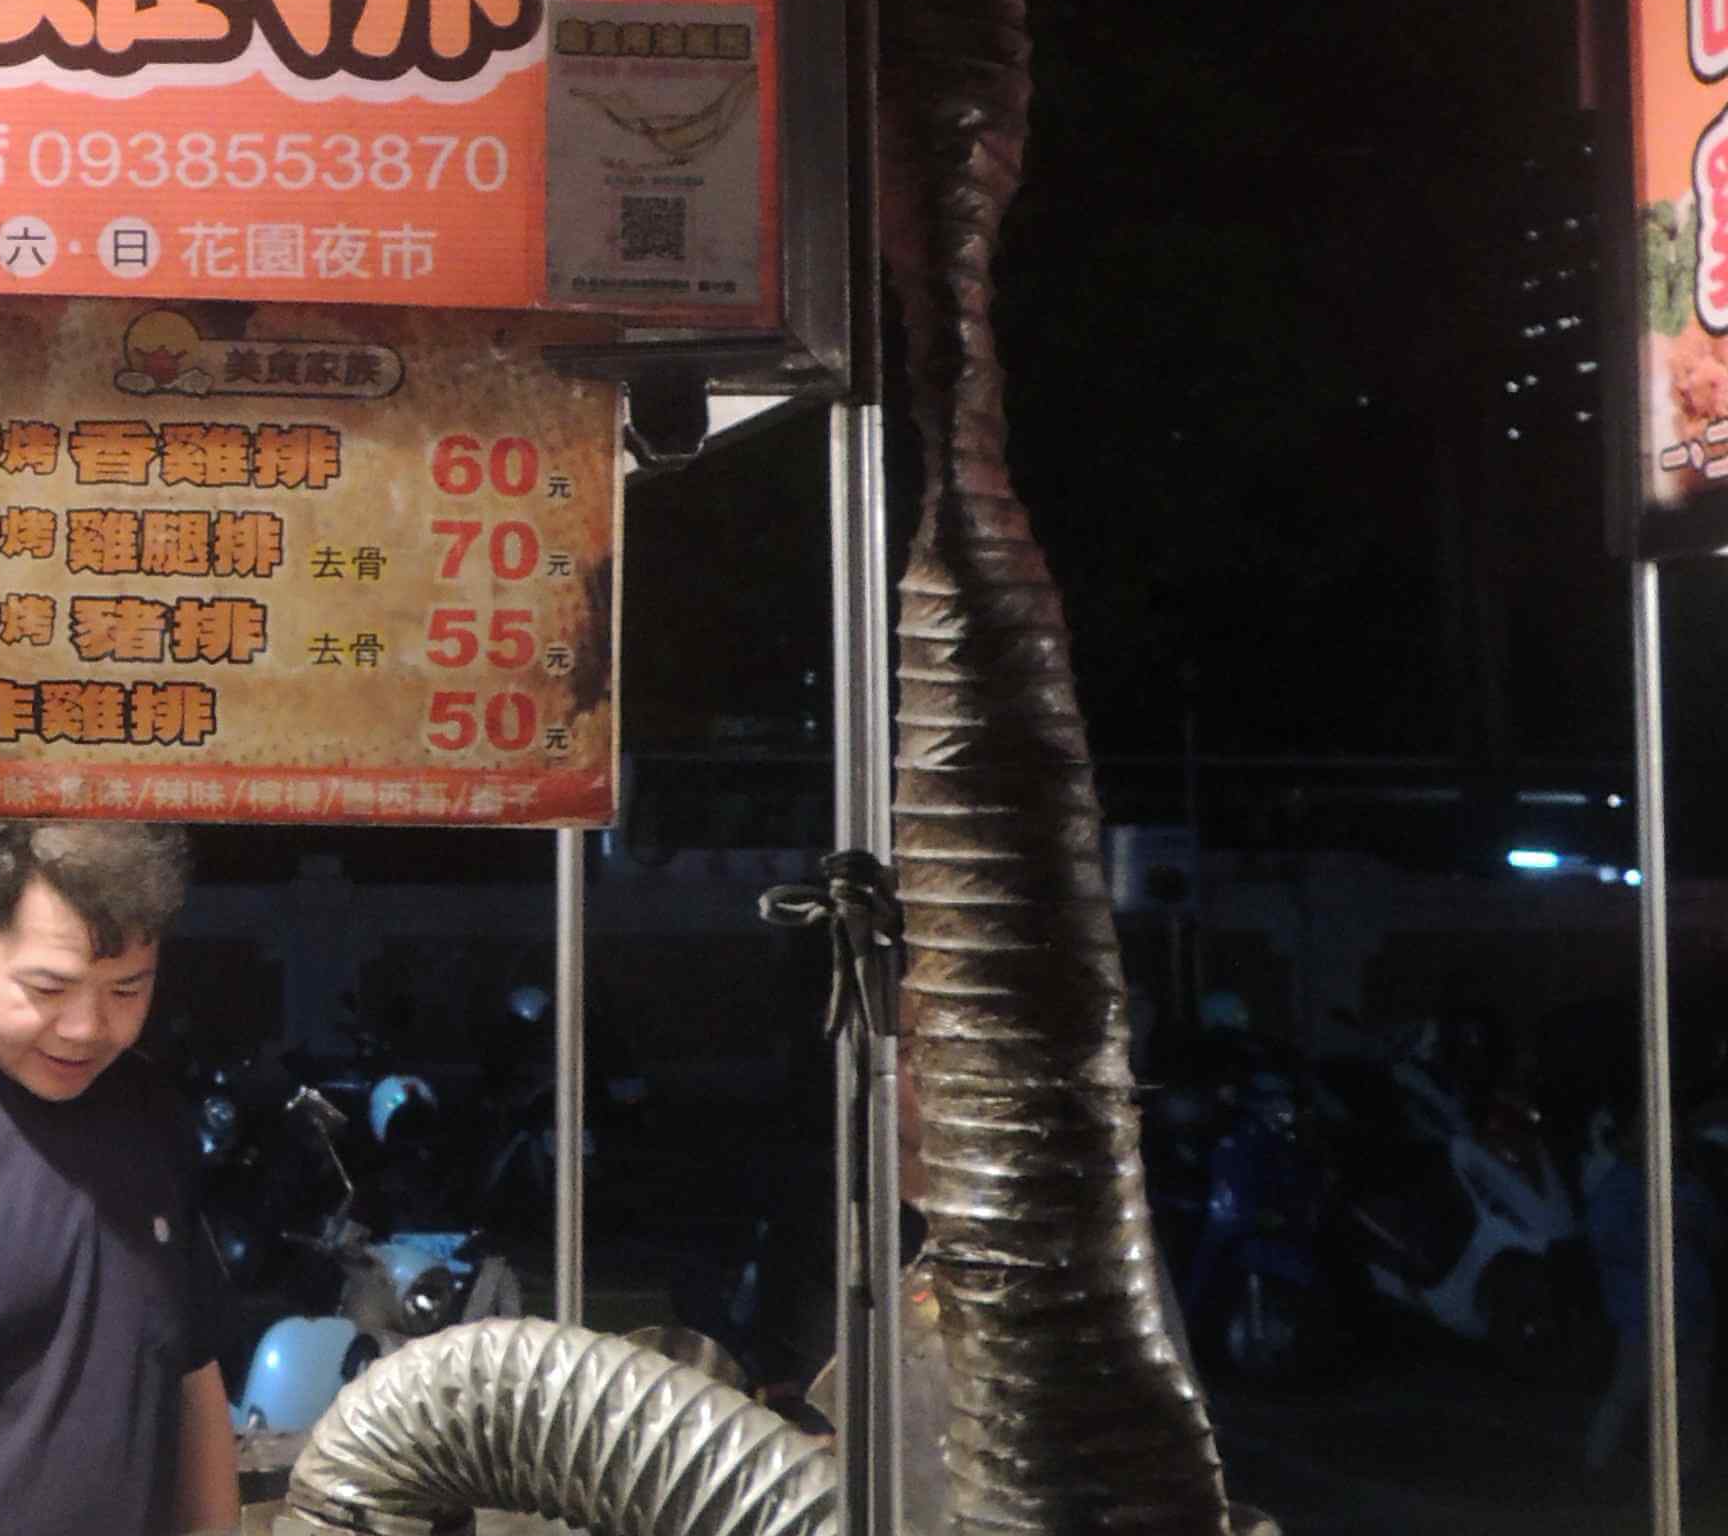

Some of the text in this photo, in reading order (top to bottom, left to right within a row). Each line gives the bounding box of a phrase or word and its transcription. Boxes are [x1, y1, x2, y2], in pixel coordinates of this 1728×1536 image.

[27, 131, 509, 194] 0938553870
[179, 221, 438, 281] 花園夜市
[311, 546, 388, 581] 去骨
[308, 633, 384, 668] 去骨
